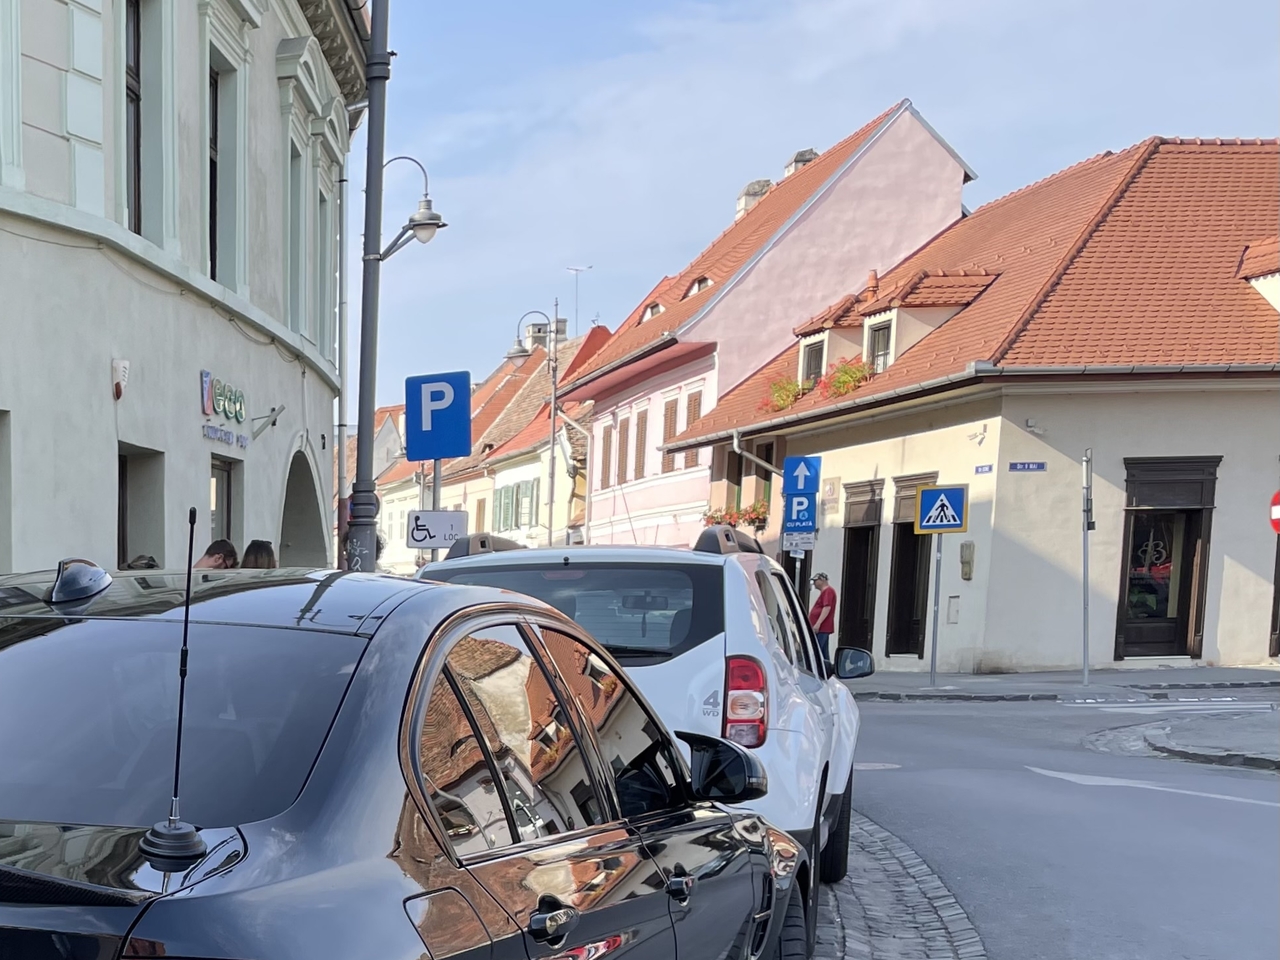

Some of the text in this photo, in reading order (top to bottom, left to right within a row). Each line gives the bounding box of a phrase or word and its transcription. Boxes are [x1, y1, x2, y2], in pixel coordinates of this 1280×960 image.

[421, 382, 455, 431] P
[792, 497, 809, 520] P
[444, 533, 458, 541] LOC
[703, 690, 720, 708] 4
